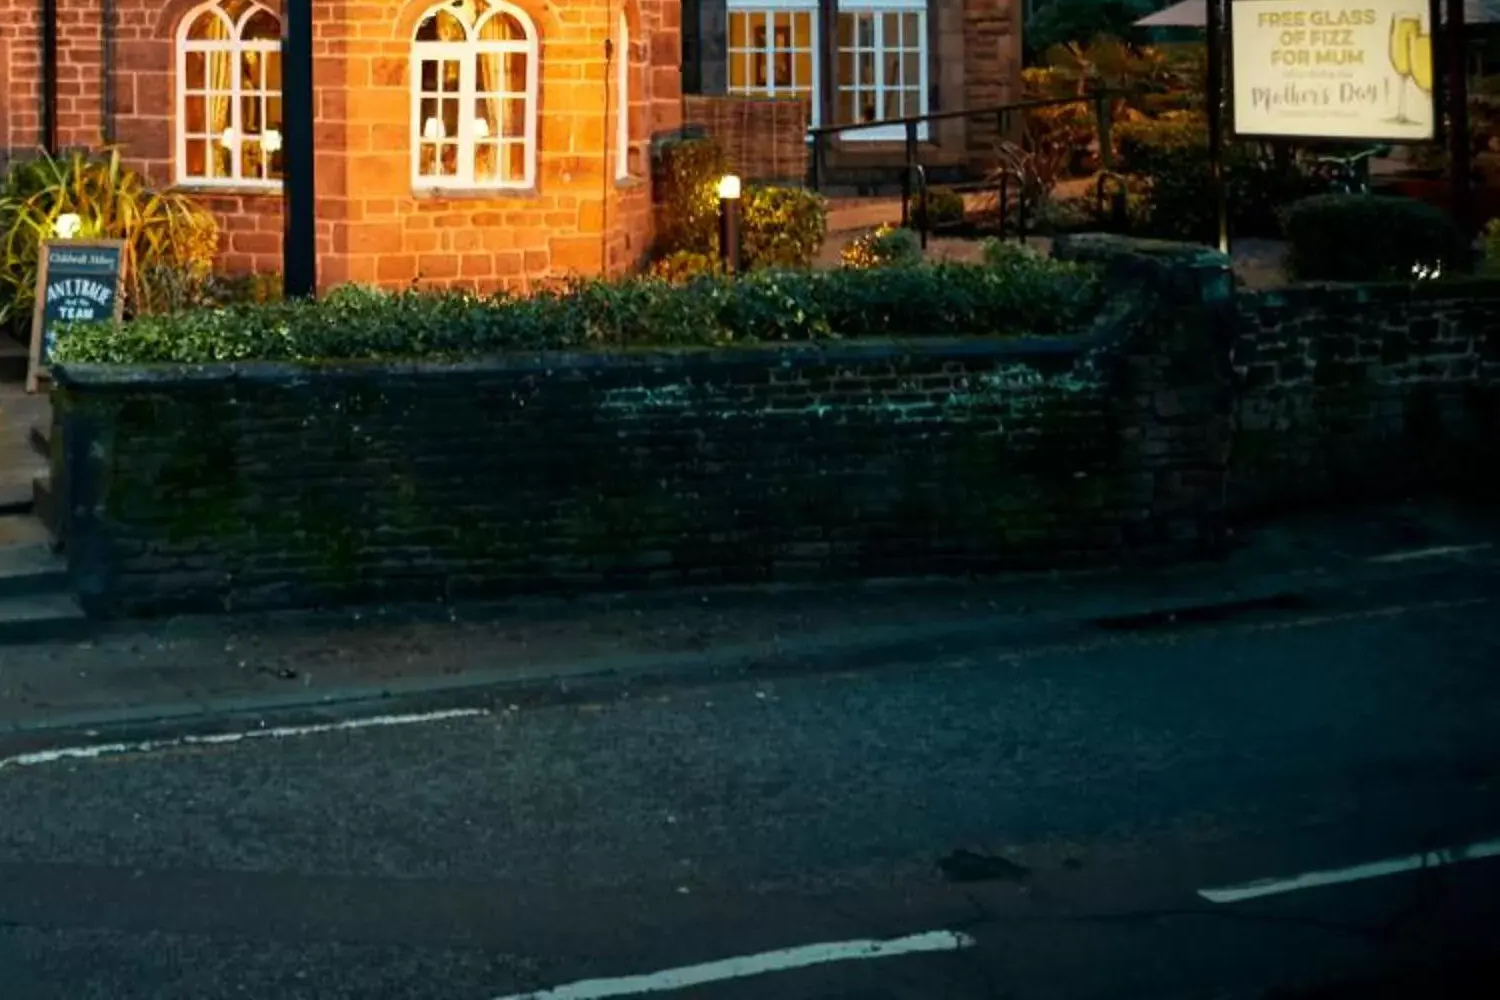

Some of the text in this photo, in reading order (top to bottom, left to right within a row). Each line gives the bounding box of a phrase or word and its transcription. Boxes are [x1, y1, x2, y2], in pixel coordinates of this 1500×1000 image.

[1257, 9, 1376, 27] FREE GLASS
[1279, 30, 1354, 46] OF FIZZ
[1270, 49, 1364, 66] FOR MUM
[1251, 81, 1330, 115] Mother's
[59, 307, 94, 319] TEAM
